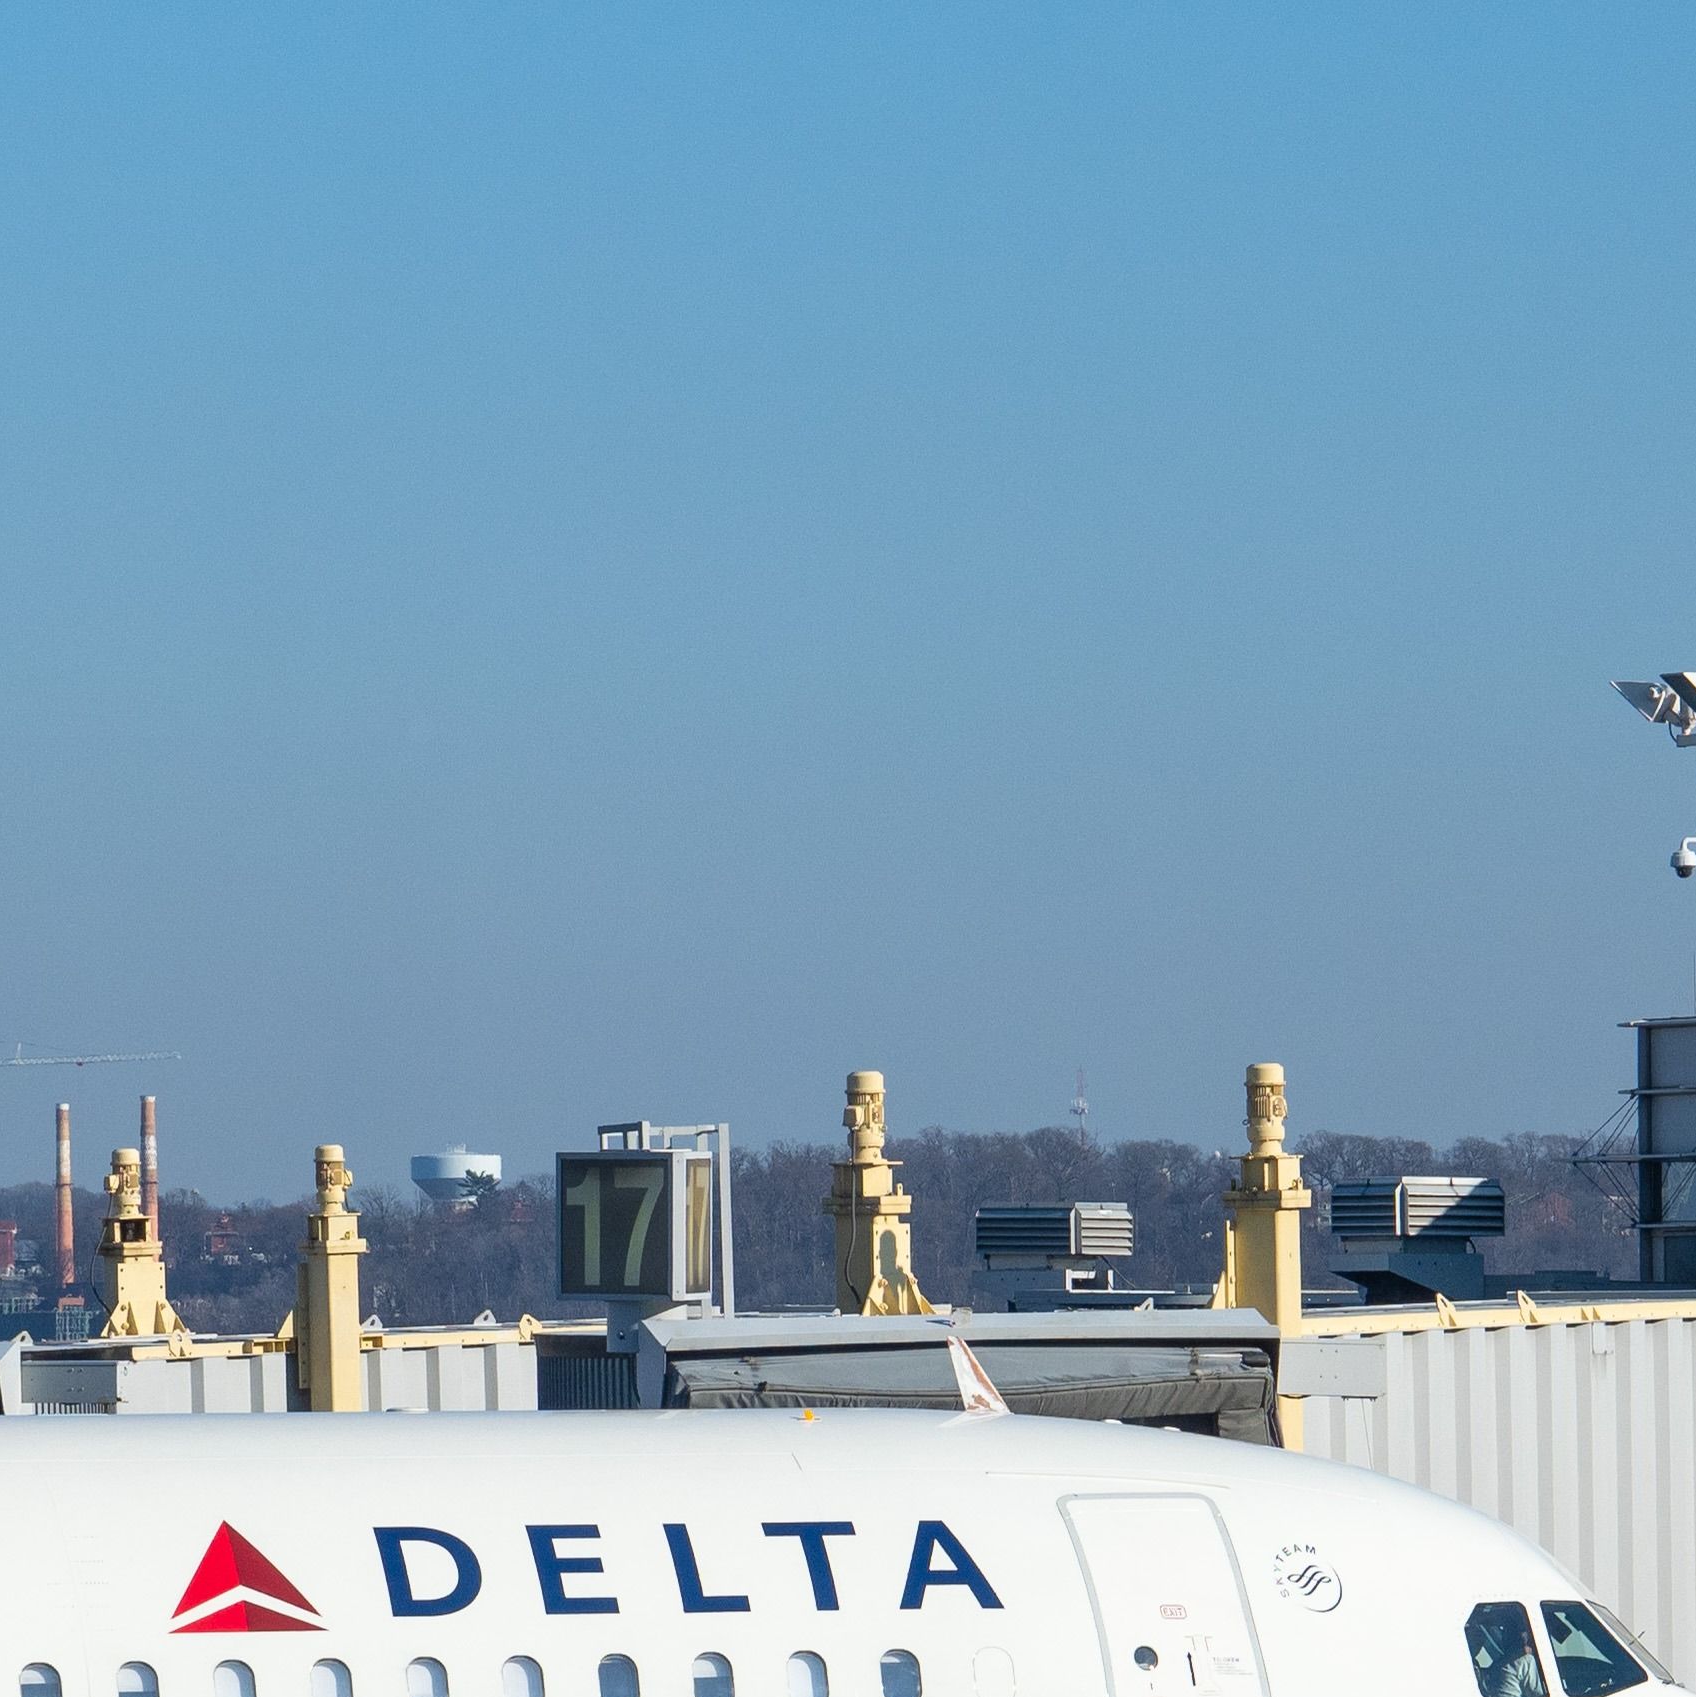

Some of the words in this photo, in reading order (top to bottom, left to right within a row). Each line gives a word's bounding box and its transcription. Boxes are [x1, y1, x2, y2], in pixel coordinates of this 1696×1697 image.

[566, 1167, 665, 1287] 17
[372, 1519, 1005, 1618] DELTA
[1273, 1543, 1316, 1598] SKYTEAM
